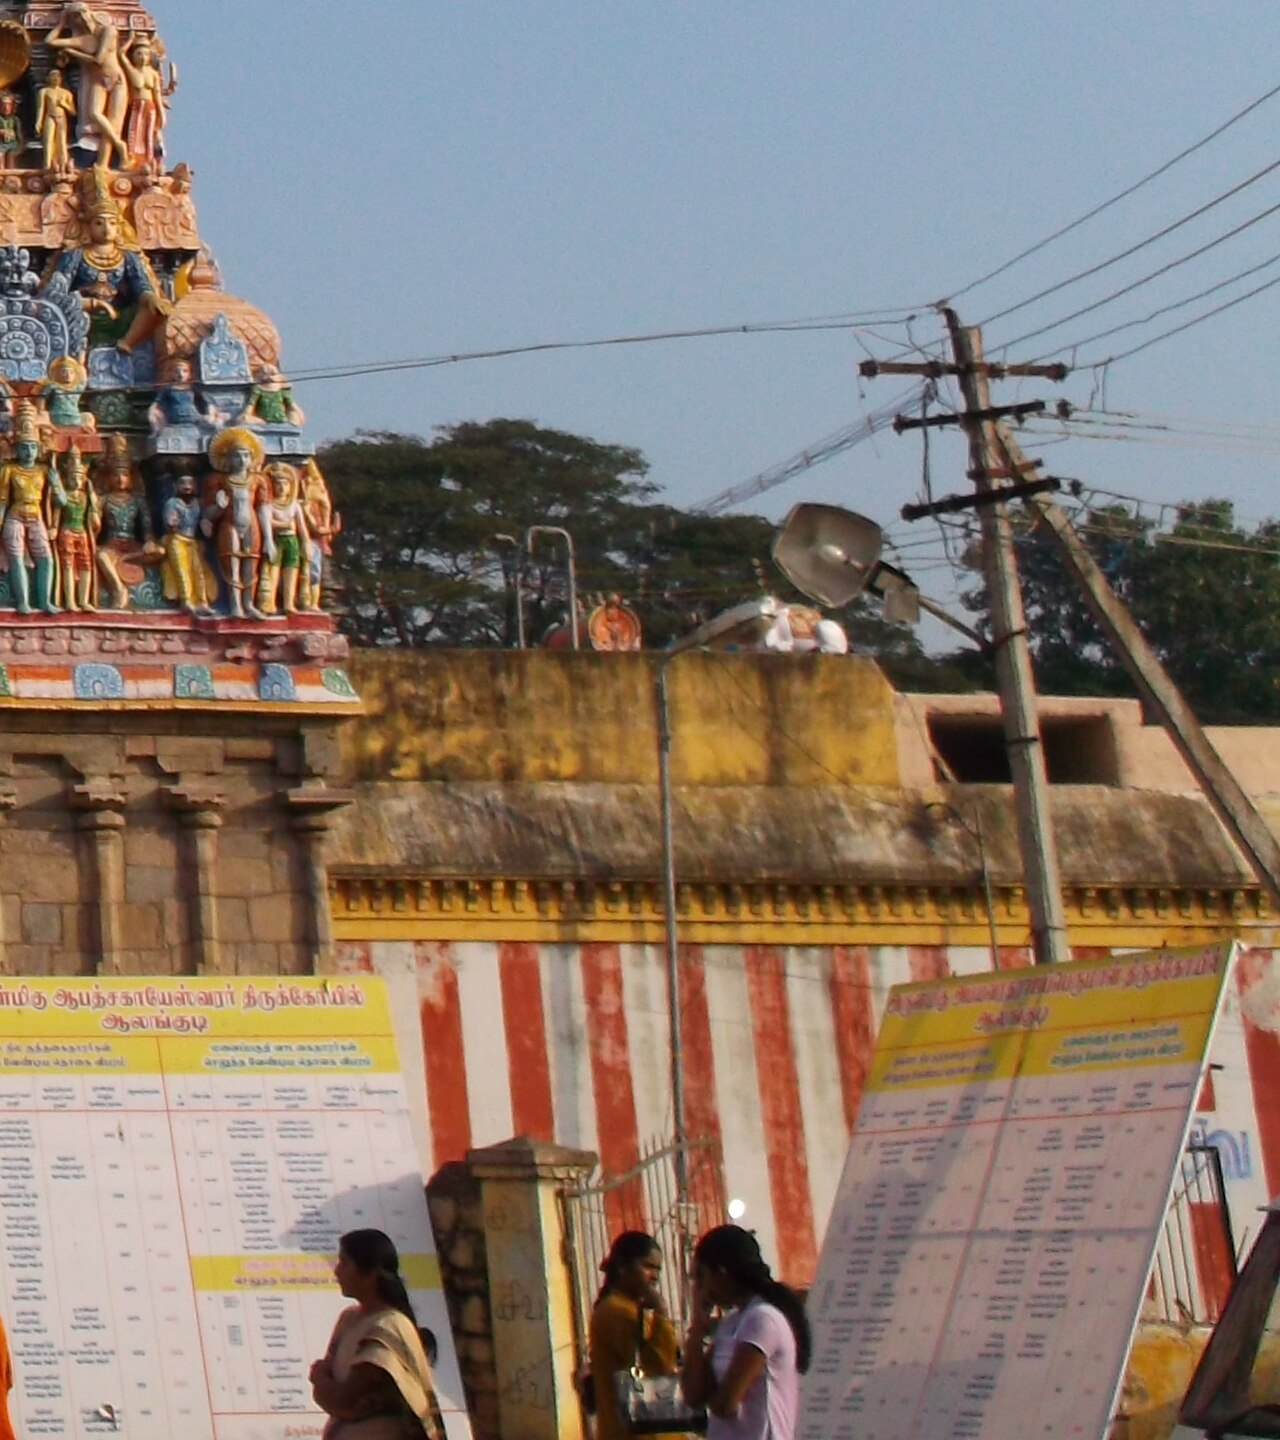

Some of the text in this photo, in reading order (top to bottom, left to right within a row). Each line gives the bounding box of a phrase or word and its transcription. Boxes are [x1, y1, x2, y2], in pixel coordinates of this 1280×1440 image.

[54, 983, 236, 1010] ஆபத்சகாயேஸ்வரர்
[242, 983, 364, 1010] திருக்கோயில்
[102, 1010, 208, 1032] ஆலங்குடி
